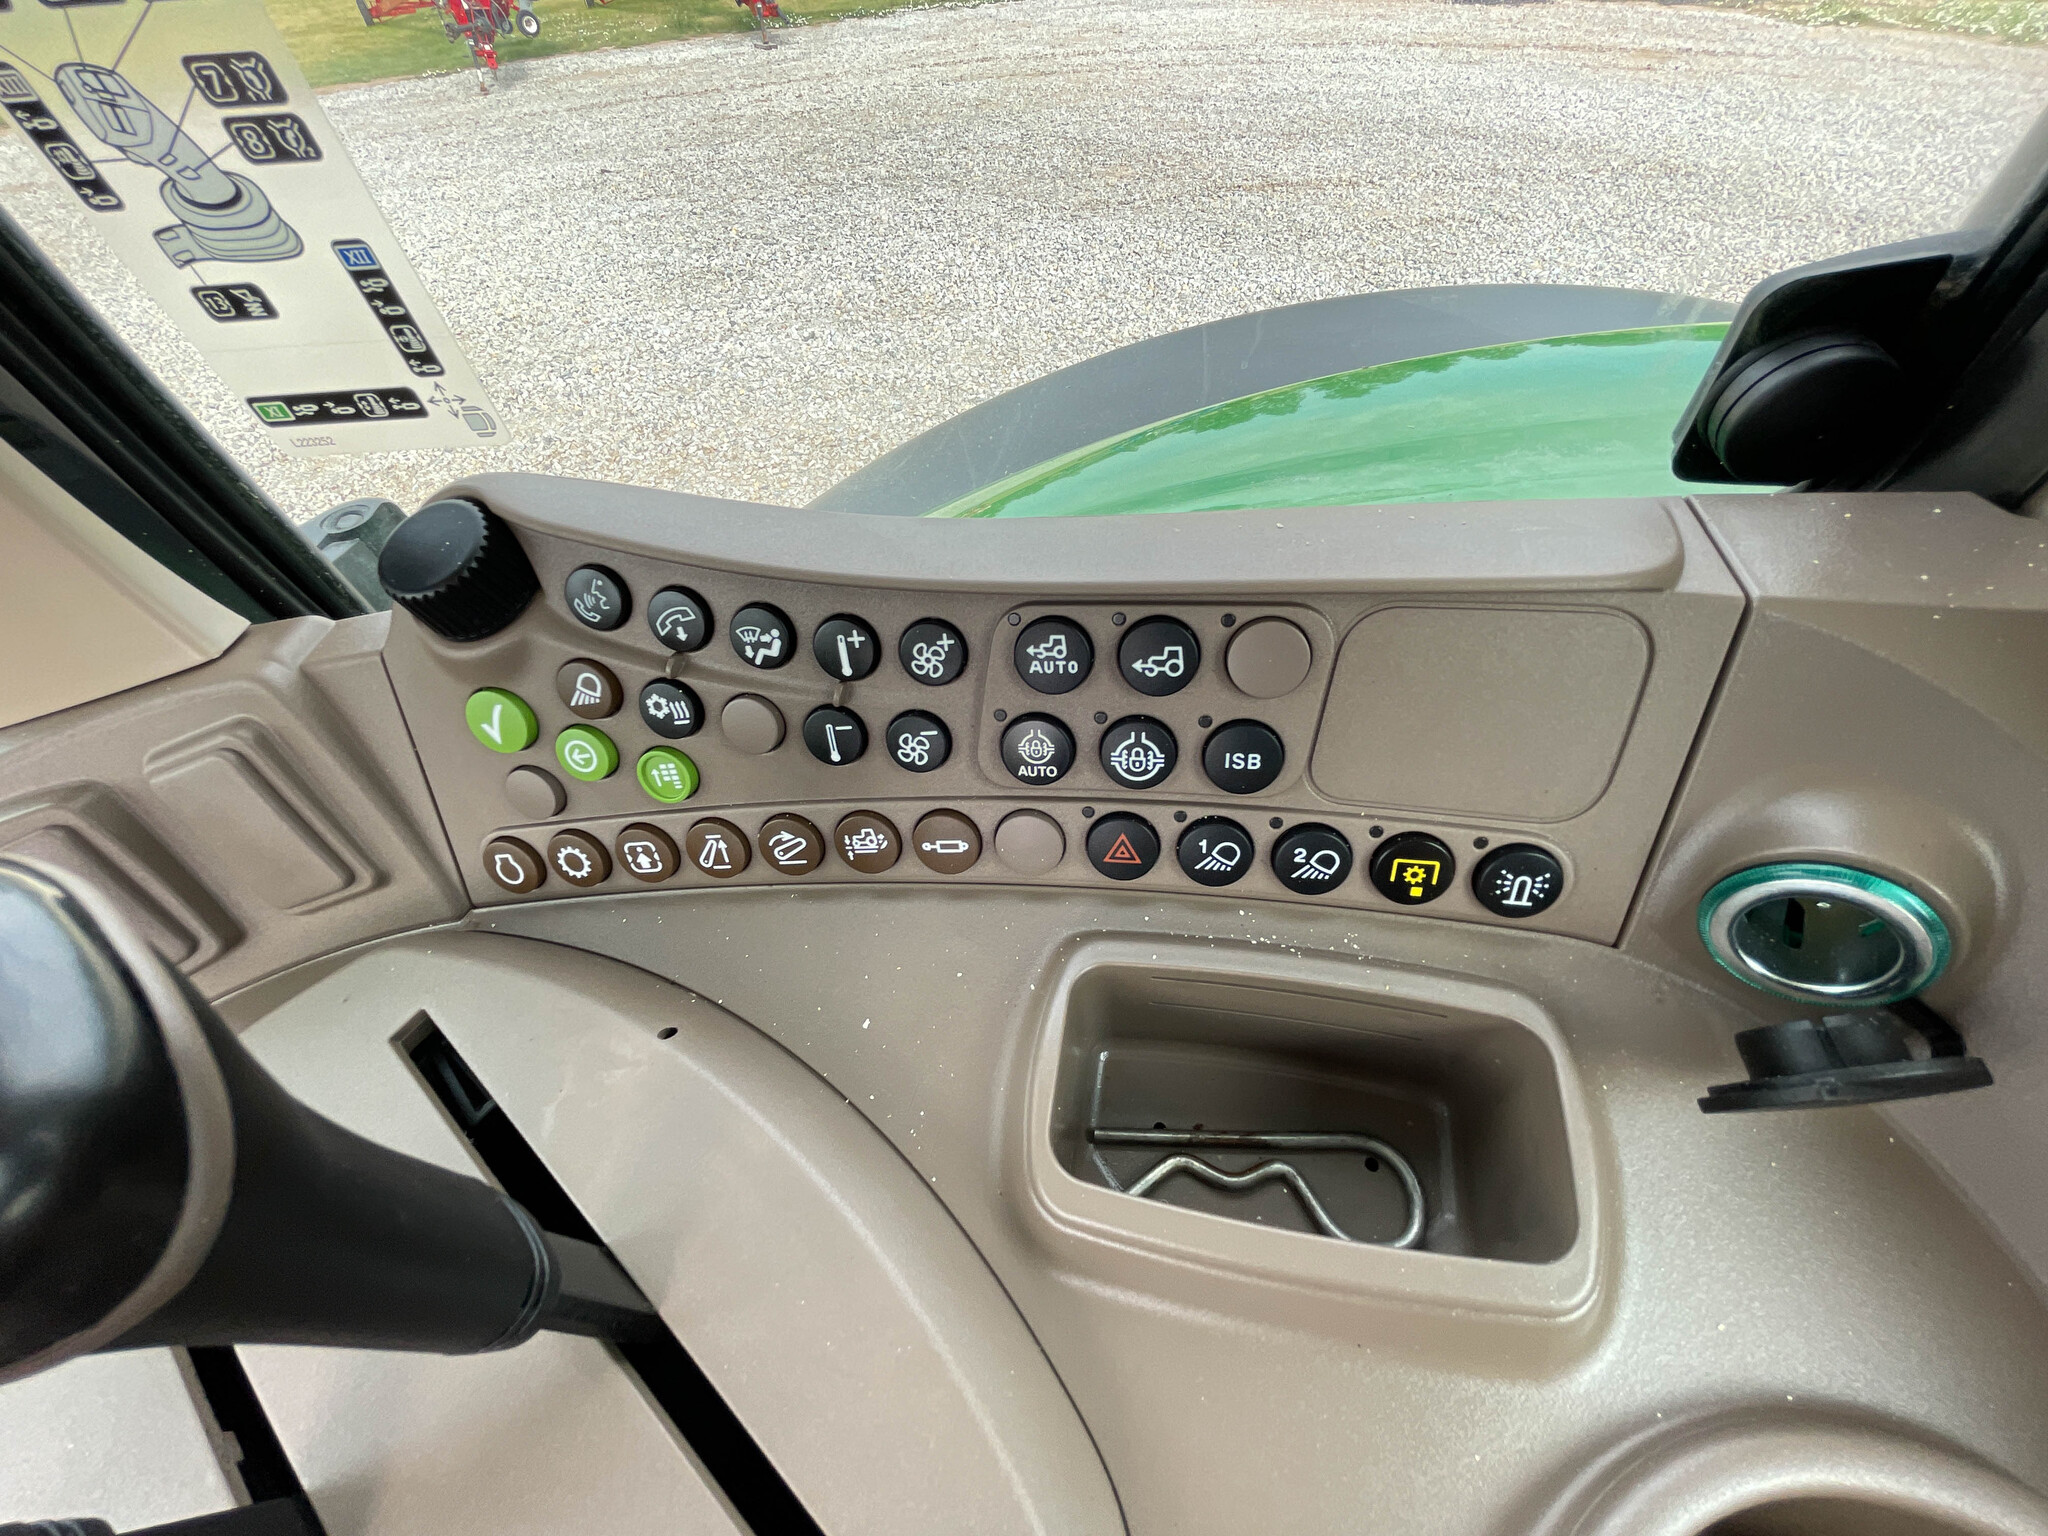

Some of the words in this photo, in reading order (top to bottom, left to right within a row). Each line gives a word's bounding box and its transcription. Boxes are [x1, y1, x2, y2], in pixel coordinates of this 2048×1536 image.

[200, 69, 222, 96] 7
[242, 129, 267, 154] 8
[342, 249, 373, 265] XII
[204, 297, 230, 311] 13
[1029, 660, 1079, 674] AUTO
[1224, 752, 1262, 770] ISB
[1017, 765, 1058, 778] AUTO
[1198, 839, 1208, 854] 1
[1293, 847, 1307, 863] 2
